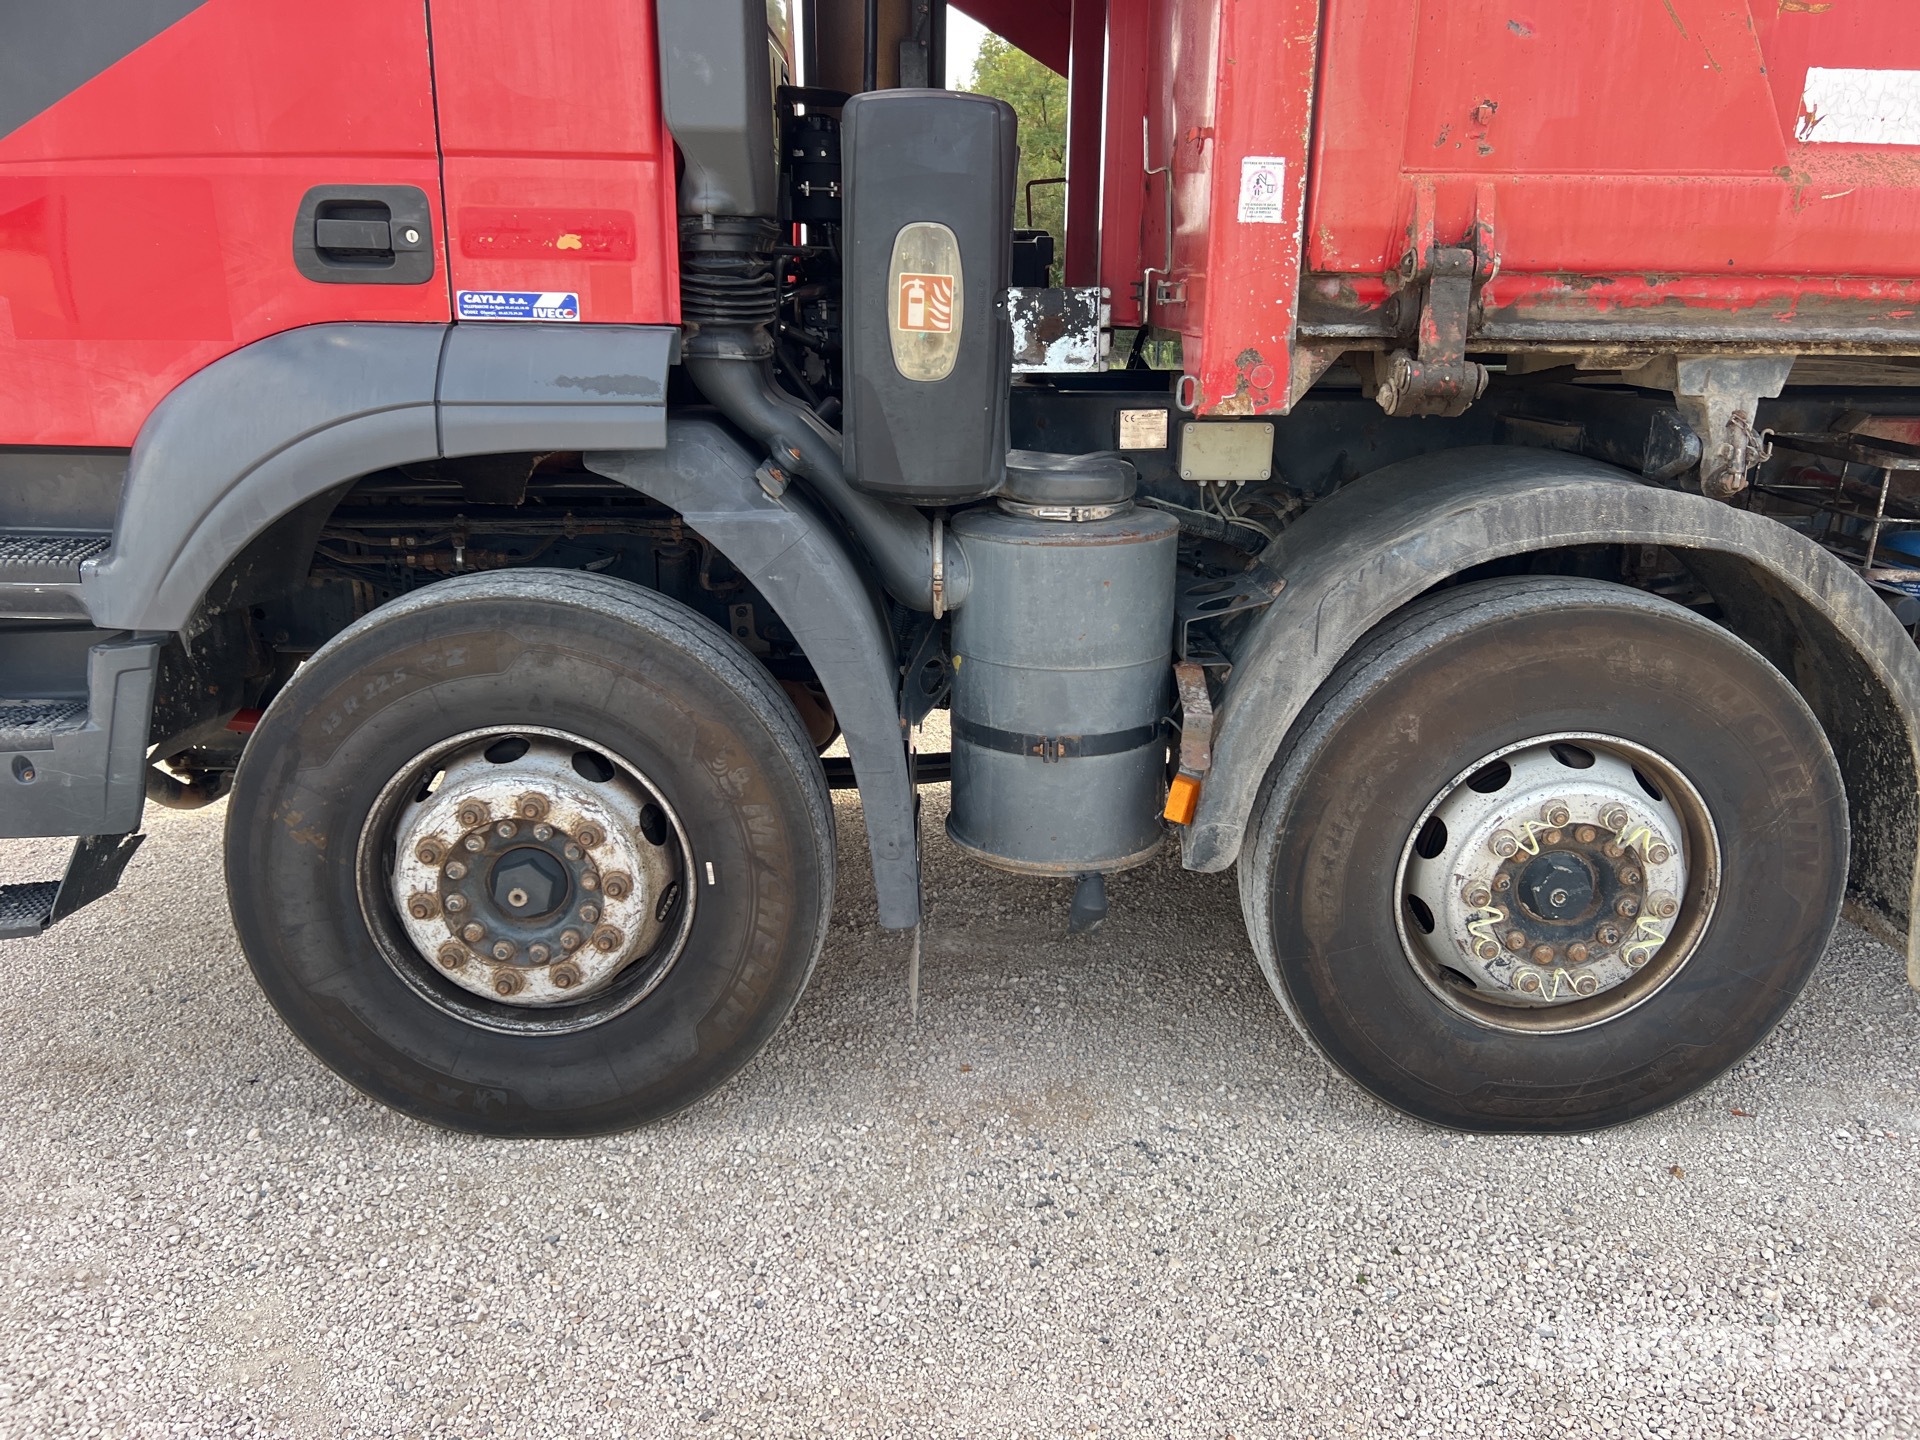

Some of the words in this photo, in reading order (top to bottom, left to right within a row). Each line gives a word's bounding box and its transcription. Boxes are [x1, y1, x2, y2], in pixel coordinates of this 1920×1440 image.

[463, 294, 506, 304] CAYLA
[532, 307, 576, 319] IVECO
[714, 803, 789, 1032] MICHELIN
